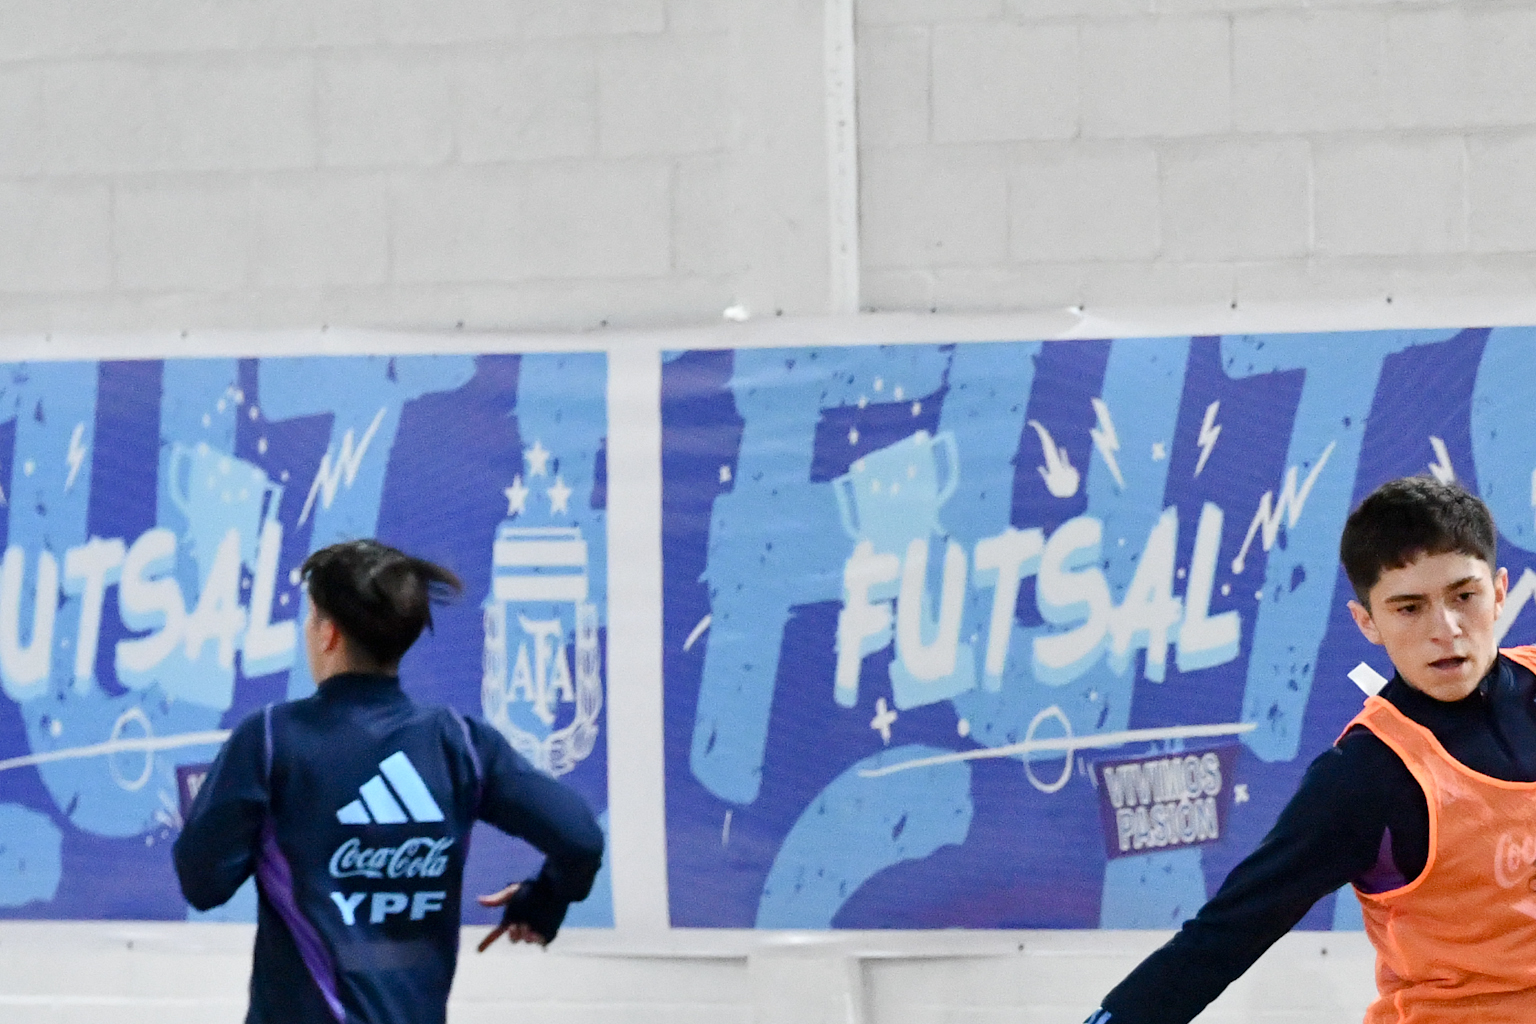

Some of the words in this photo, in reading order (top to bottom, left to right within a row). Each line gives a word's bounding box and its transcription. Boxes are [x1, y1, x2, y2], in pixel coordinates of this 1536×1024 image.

[0, 518, 298, 704] UTSAL
[834, 500, 1241, 708] FUTSAL
[506, 614, 576, 727] AFA
[1103, 752, 1223, 809] VIVIMOS
[328, 836, 455, 879] Coca-Cola
[329, 891, 447, 926] YPF
